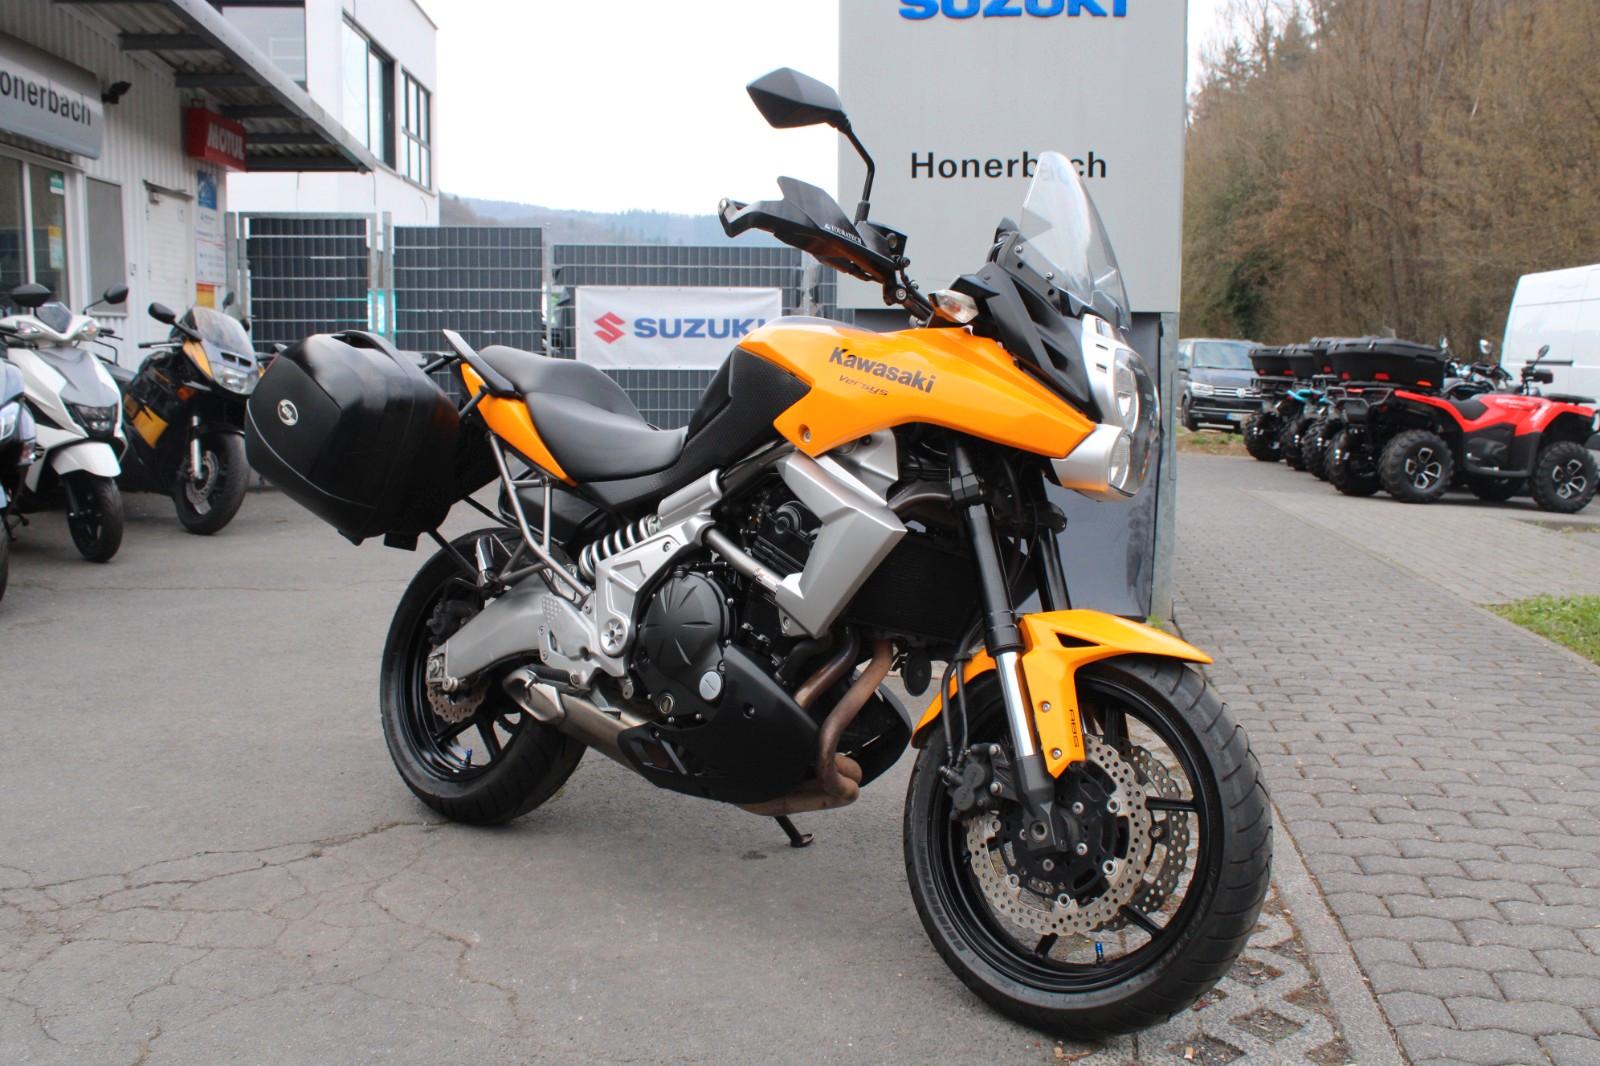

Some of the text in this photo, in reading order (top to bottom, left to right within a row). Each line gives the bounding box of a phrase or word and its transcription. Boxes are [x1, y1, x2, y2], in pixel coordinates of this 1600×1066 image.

[207, 121, 245, 161] MOTUL
[911, 151, 1107, 179] Honerbch
[828, 346, 936, 394] Kawasaki
